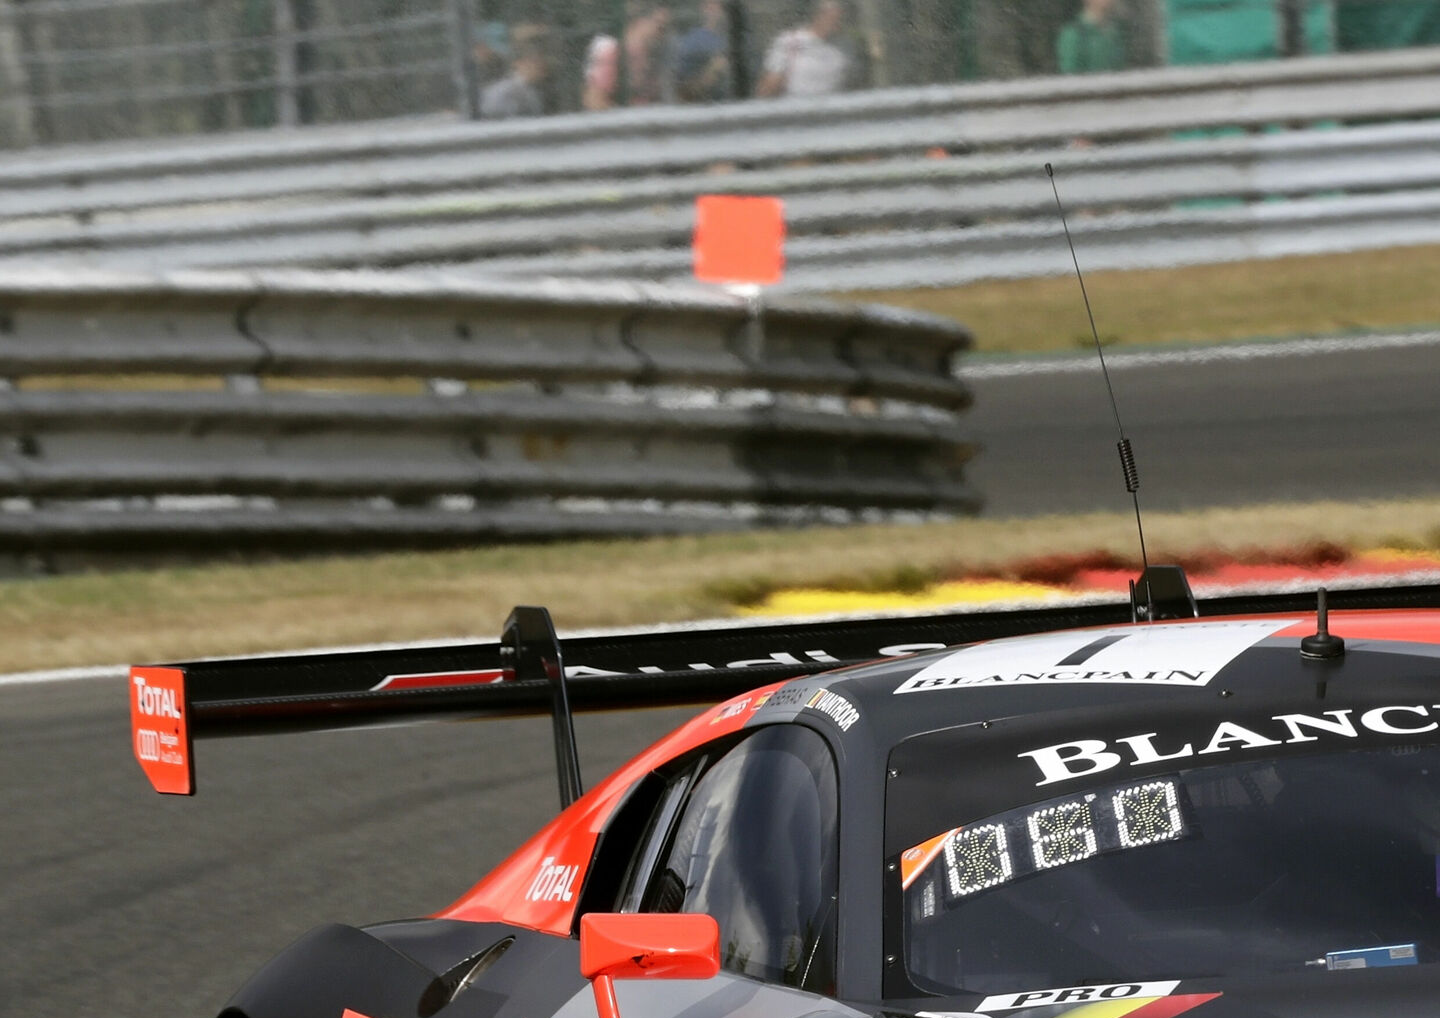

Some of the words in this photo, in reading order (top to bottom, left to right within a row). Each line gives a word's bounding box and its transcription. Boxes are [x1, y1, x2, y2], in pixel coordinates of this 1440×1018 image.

[133, 676, 181, 719] TOTAL
[911, 670, 1211, 689] BLANCPAIN
[815, 690, 861, 732] VANTHOOR
[525, 856, 579, 902] TOTAL
[1010, 984, 1142, 1007] PRO
